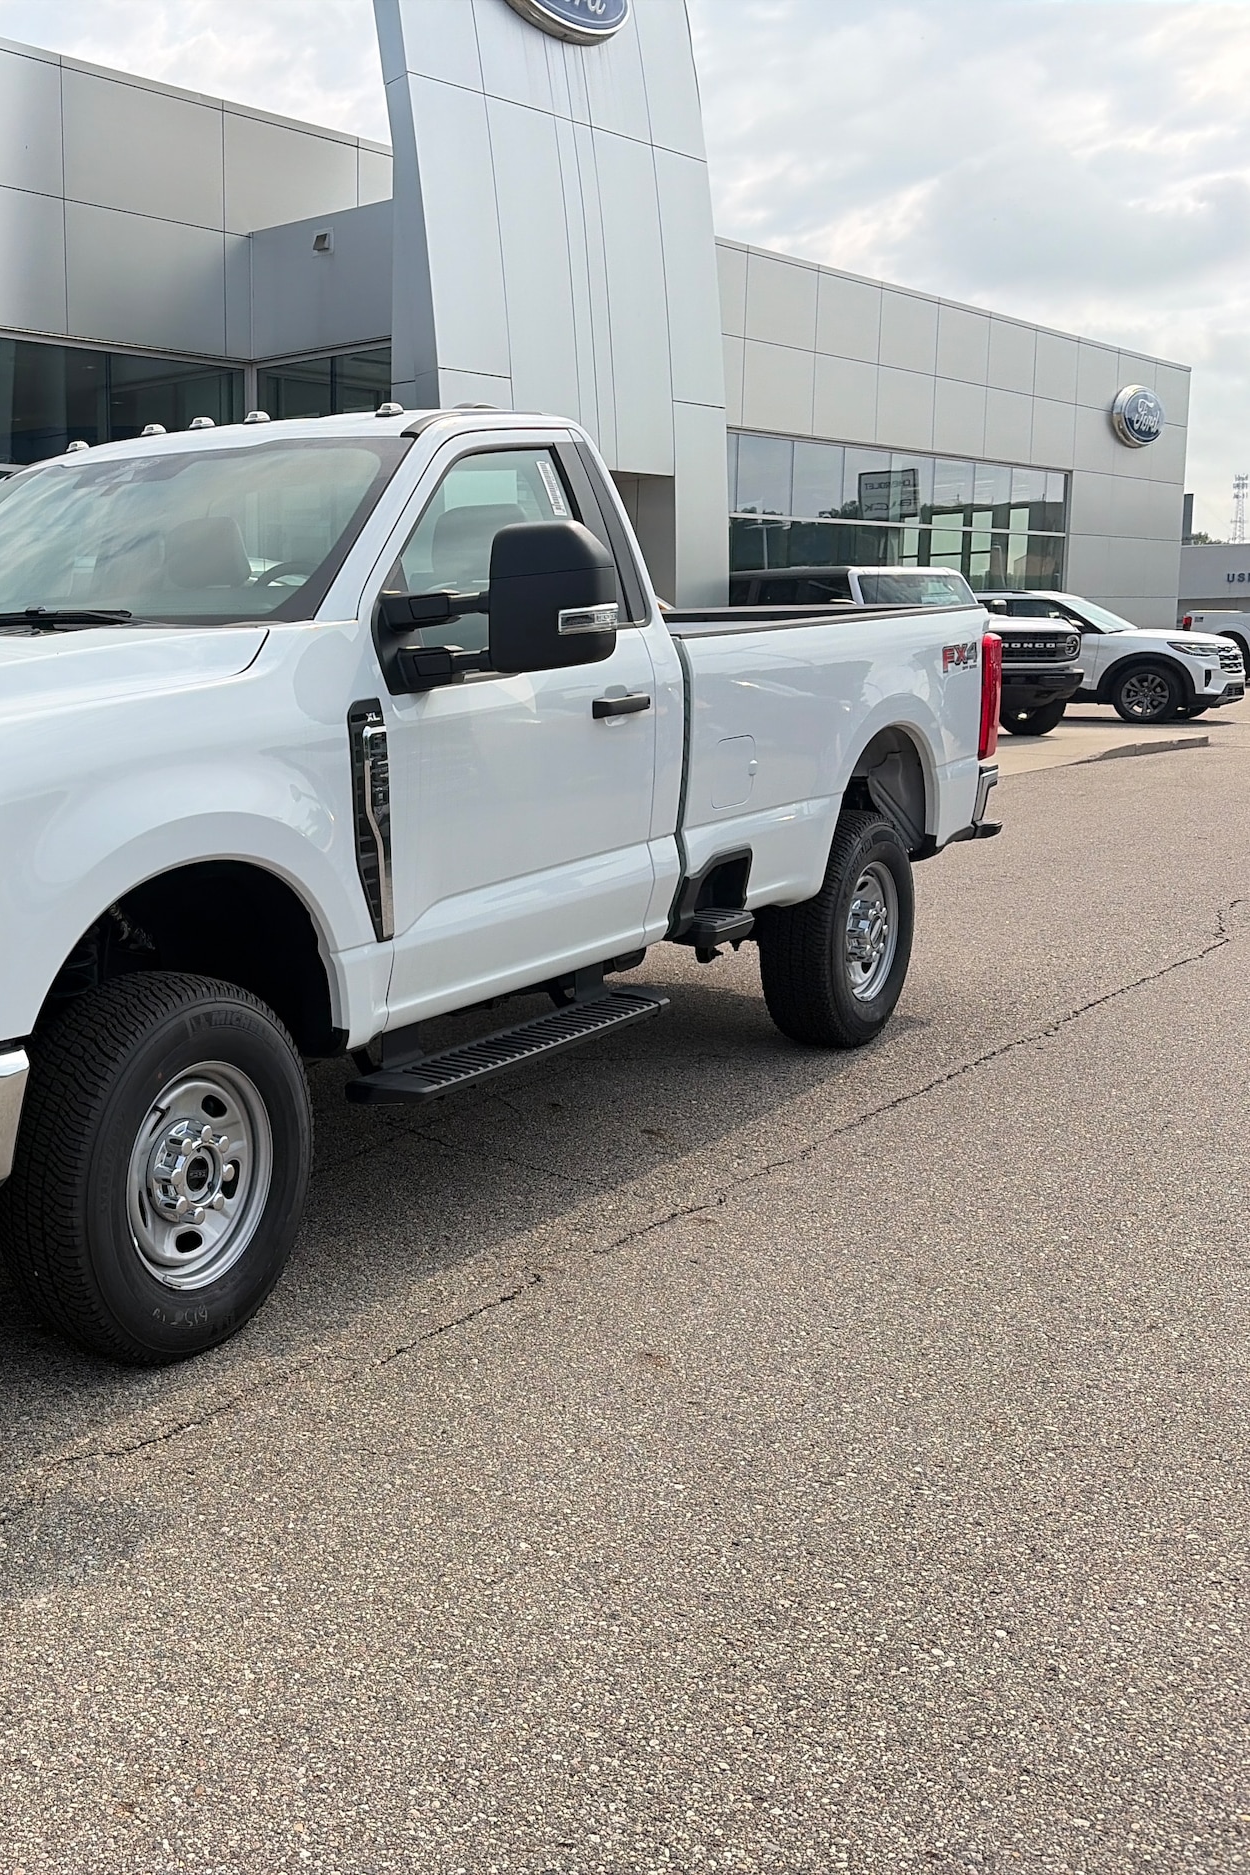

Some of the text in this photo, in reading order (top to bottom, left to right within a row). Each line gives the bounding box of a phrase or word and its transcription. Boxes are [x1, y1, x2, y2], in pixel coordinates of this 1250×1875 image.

[1133, 398, 1161, 433] Ford
[942, 641, 978, 673] FX4
[365, 712, 381, 722] XL
